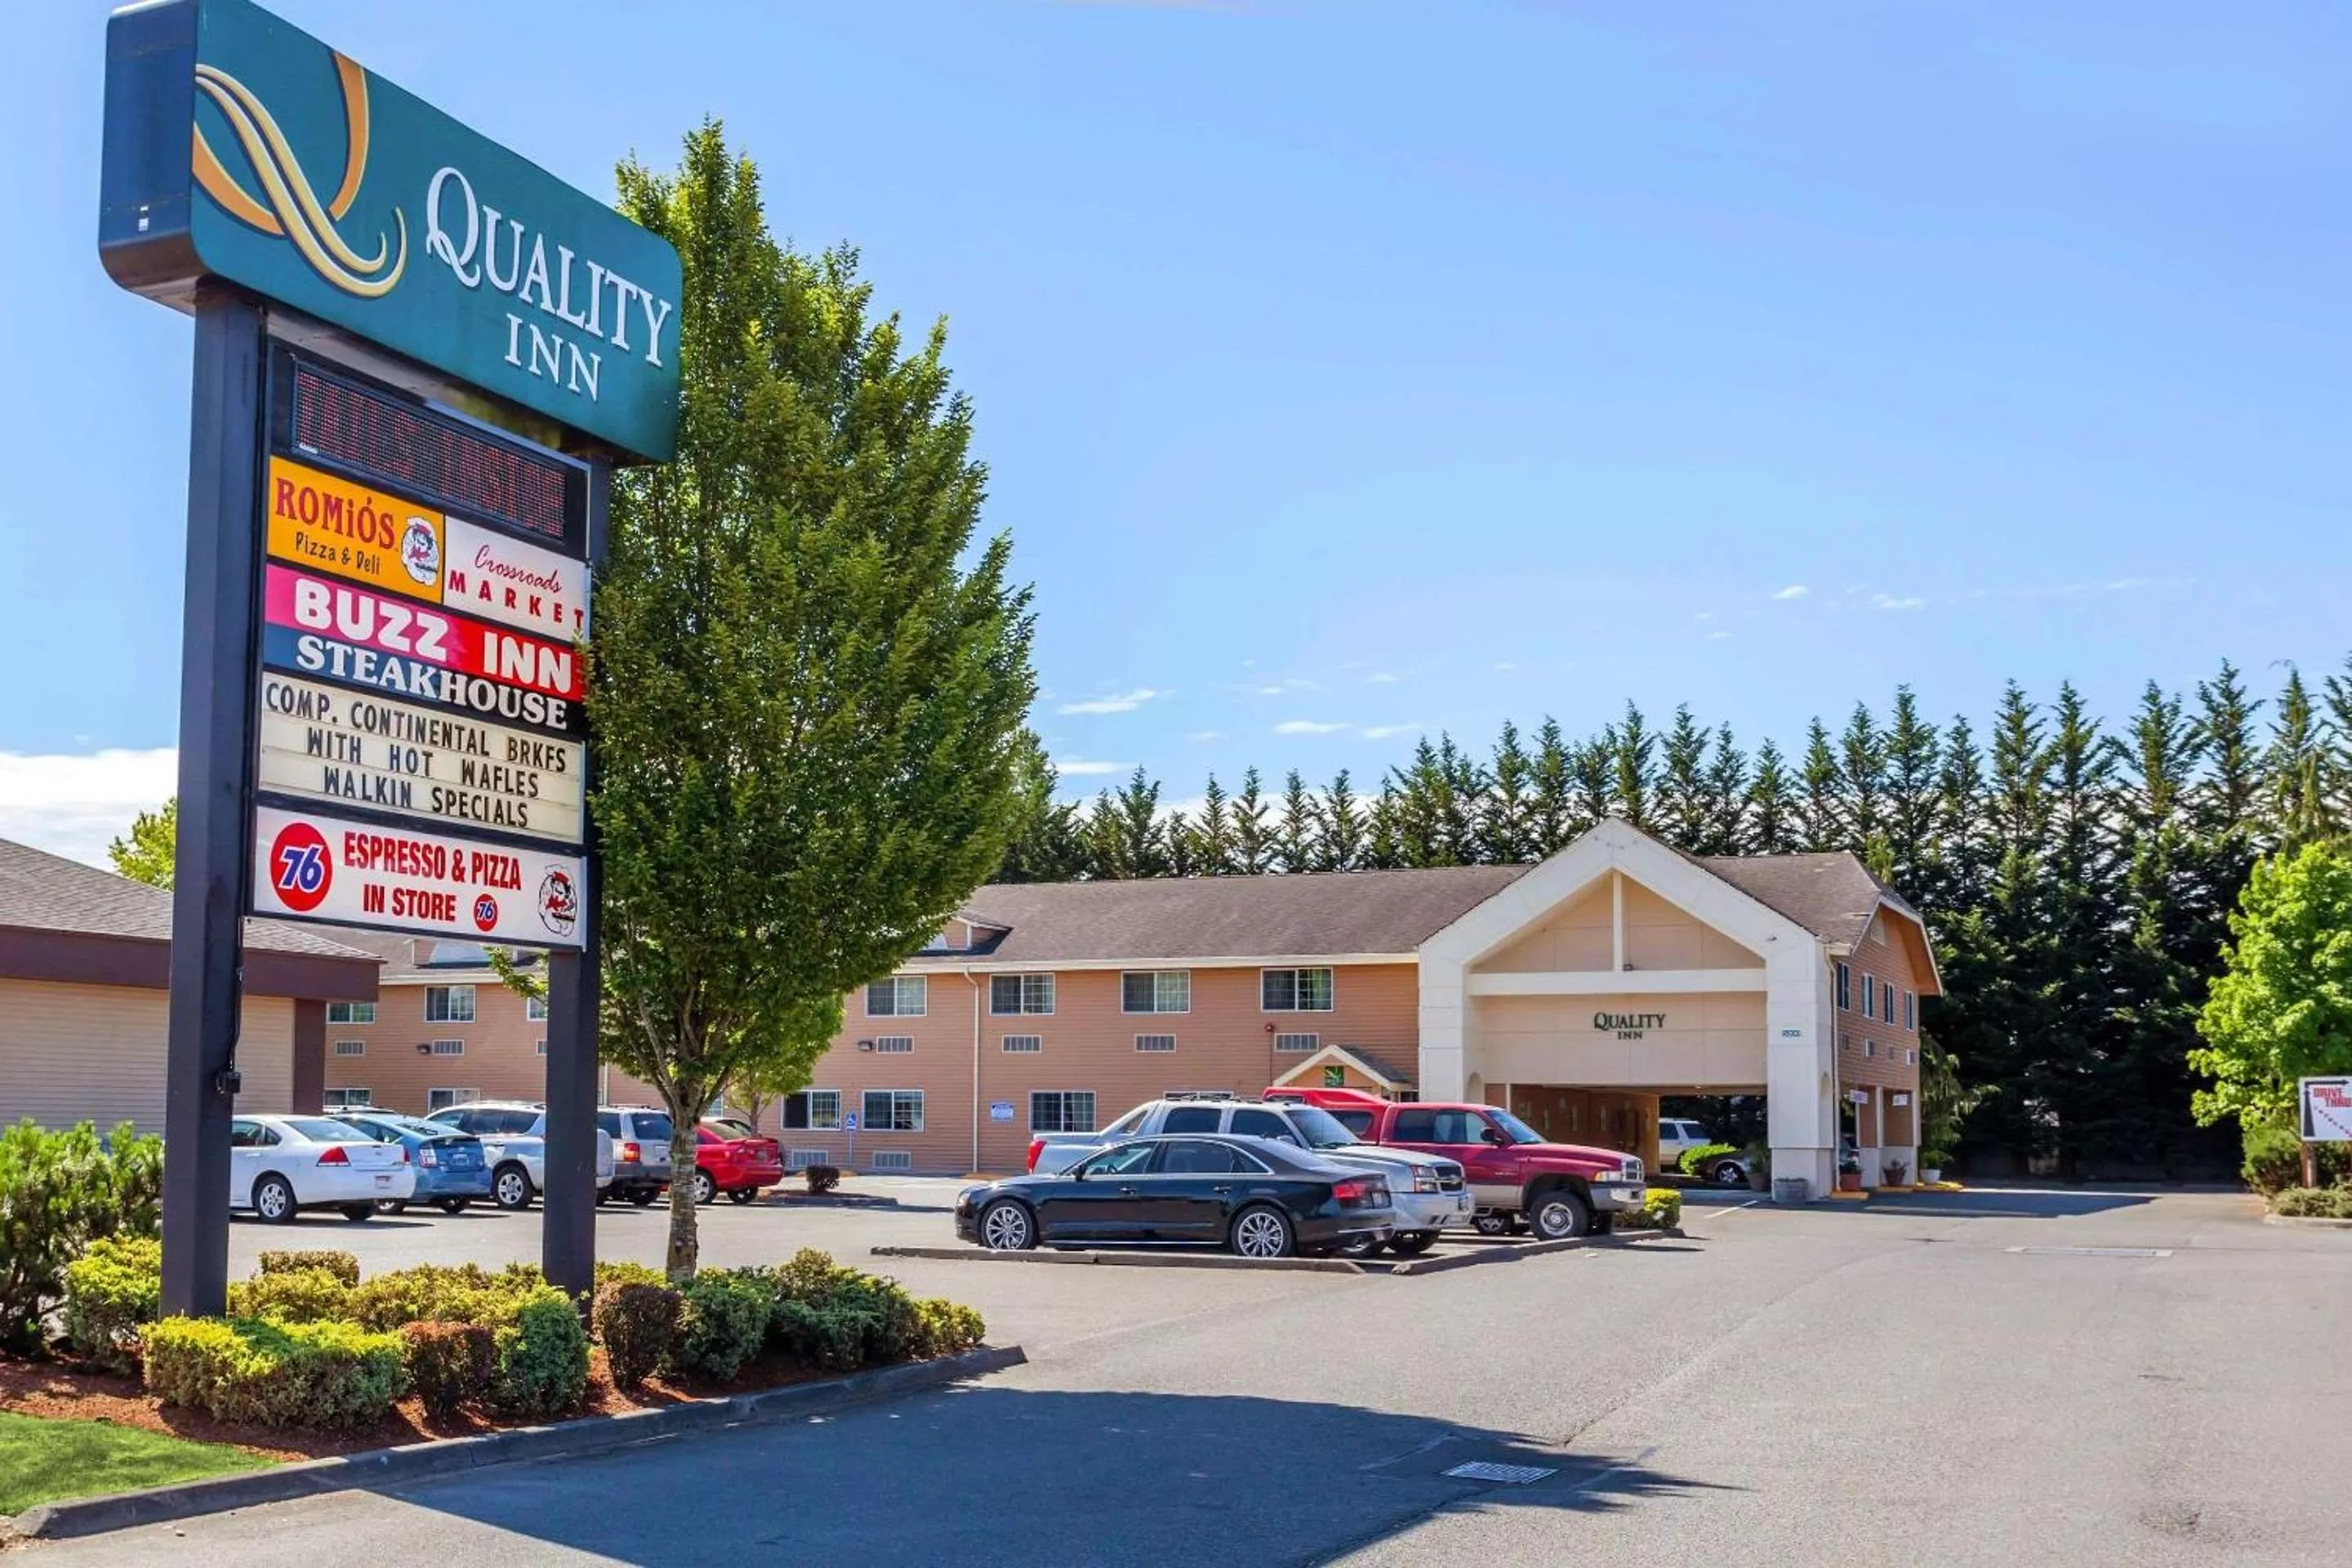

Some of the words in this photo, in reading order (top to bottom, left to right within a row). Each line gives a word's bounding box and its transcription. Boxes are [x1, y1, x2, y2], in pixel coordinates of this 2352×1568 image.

[426, 167, 672, 368] QUALITY
[506, 313, 601, 402] INN
[295, 532, 336, 560] Pizza
[341, 546, 351, 565] &
[356, 551, 381, 575] Deli
[474, 545, 563, 594] Crossroads
[448, 569, 584, 628] MARKET
[294, 578, 449, 662] BUZZ
[483, 630, 572, 694] INN
[296, 635, 567, 730] STEAKHOUSE
[265, 682, 338, 724] COMP.
[350, 701, 490, 756] CONTINENTAL
[506, 739, 567, 773] BRKFS
[307, 727, 362, 765] WITH
[389, 745, 434, 777] HOT
[461, 759, 539, 798] WAFLES
[324, 766, 412, 808] WALKIN
[431, 787, 528, 828] SPECIALS
[281, 844, 323, 892] 76
[344, 831, 446, 880] ESPRESSO
[451, 849, 466, 884] &
[471, 852, 522, 891] PIZZA
[363, 884, 385, 914] IN
[392, 886, 457, 921] STORE
[475, 901, 493, 920] 76
[1593, 1012, 1665, 1031] QUALITY
[1618, 1031, 1642, 1040] INN
